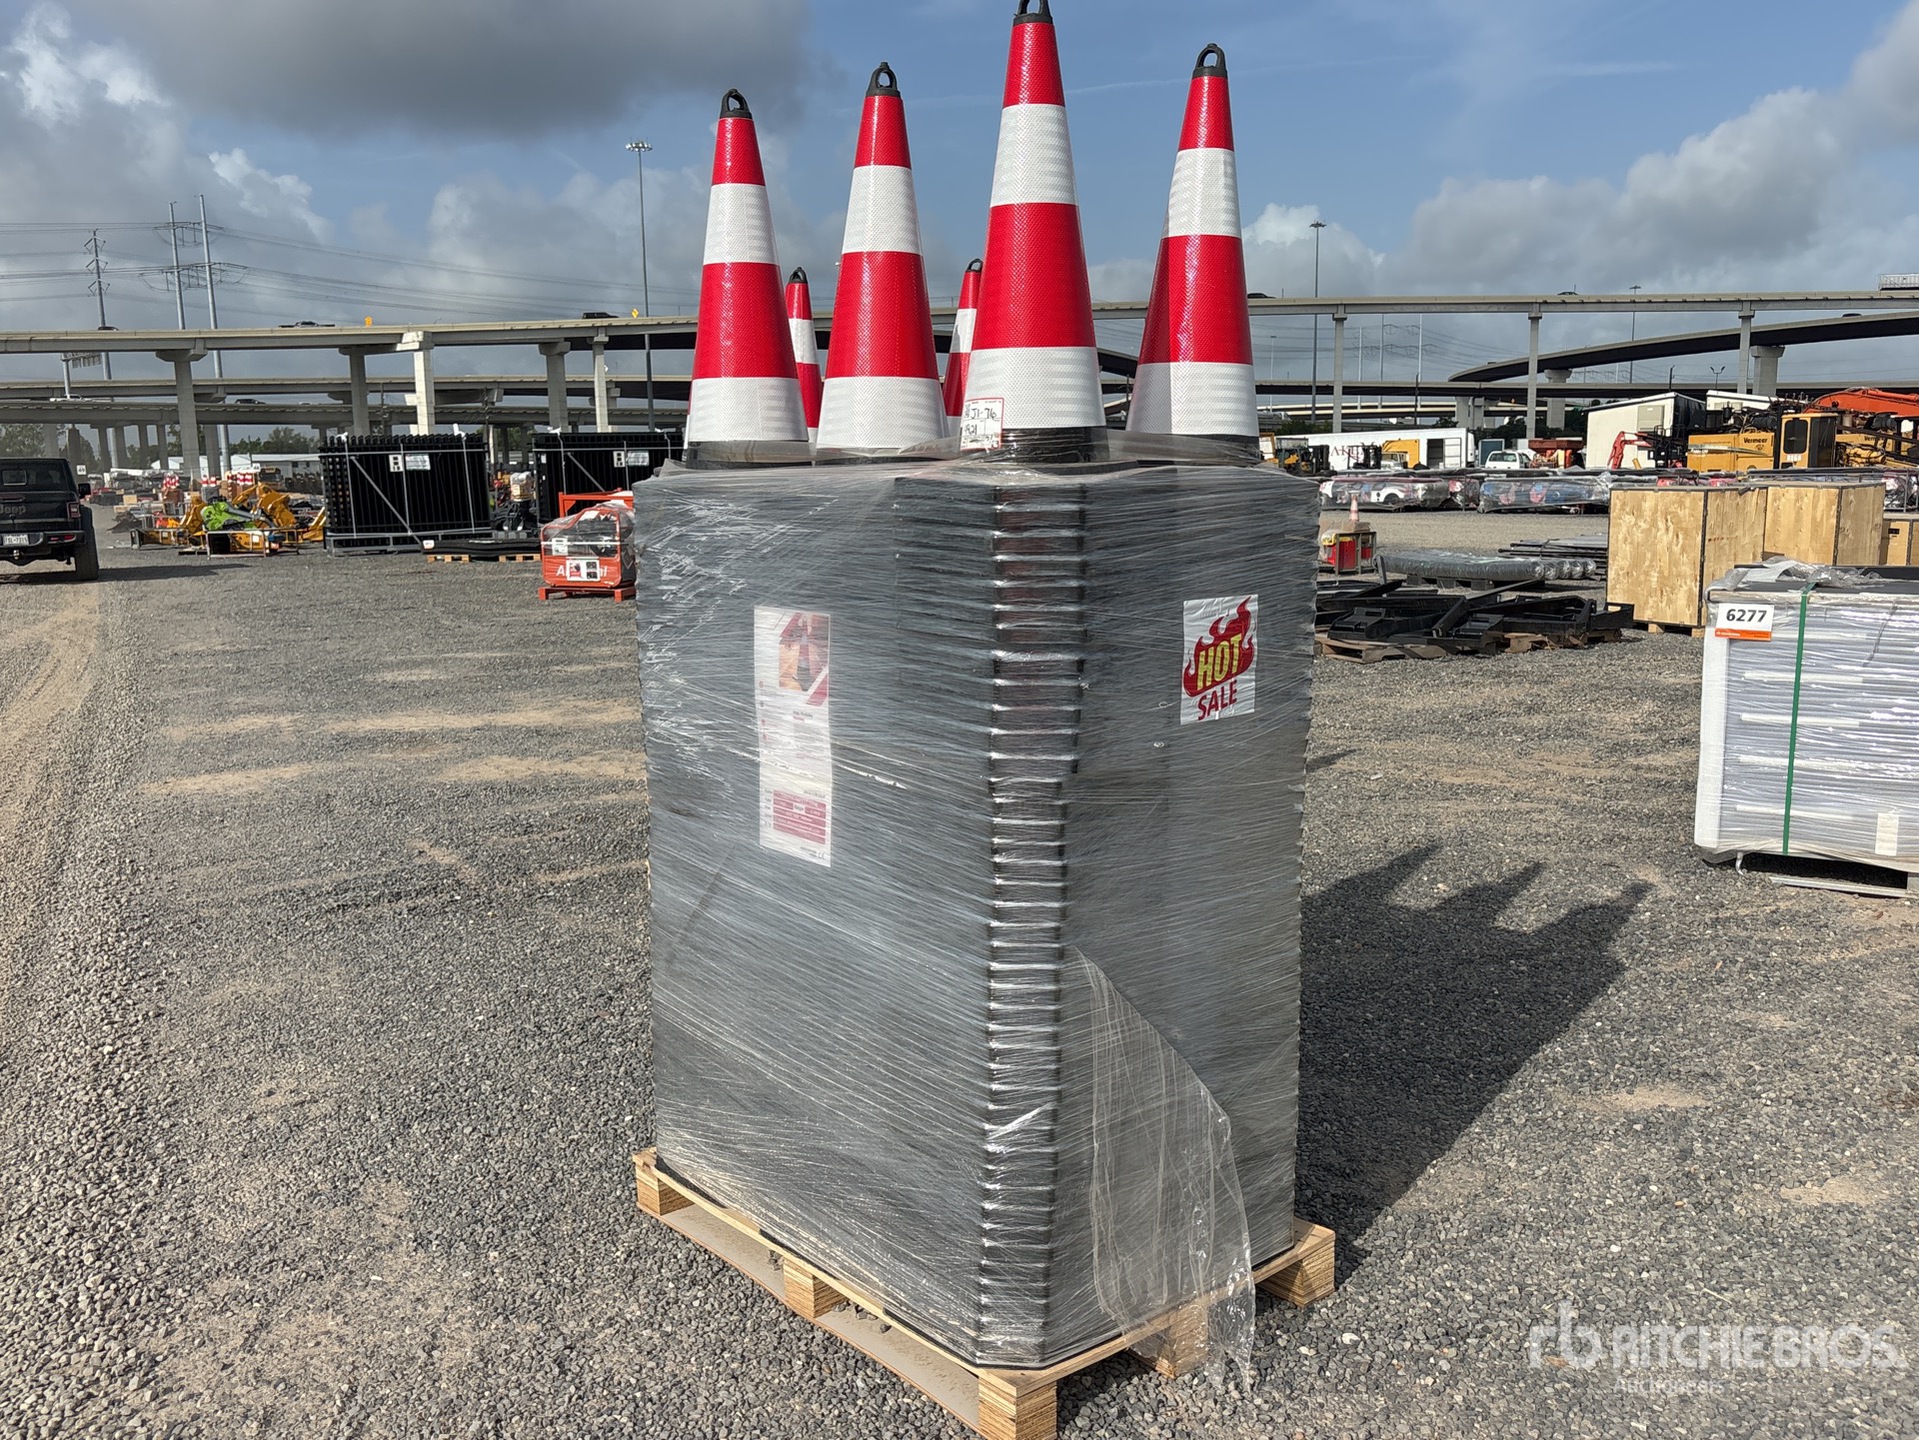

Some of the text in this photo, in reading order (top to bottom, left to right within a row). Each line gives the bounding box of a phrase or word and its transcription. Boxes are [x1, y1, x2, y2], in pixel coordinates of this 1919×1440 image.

[1744, 436, 1768, 444] Vermeer
[0, 504, 26, 515] Jeep
[1726, 608, 1767, 622] 6277
[1197, 633, 1241, 691] HOT
[1198, 680, 1237, 720] SALE
